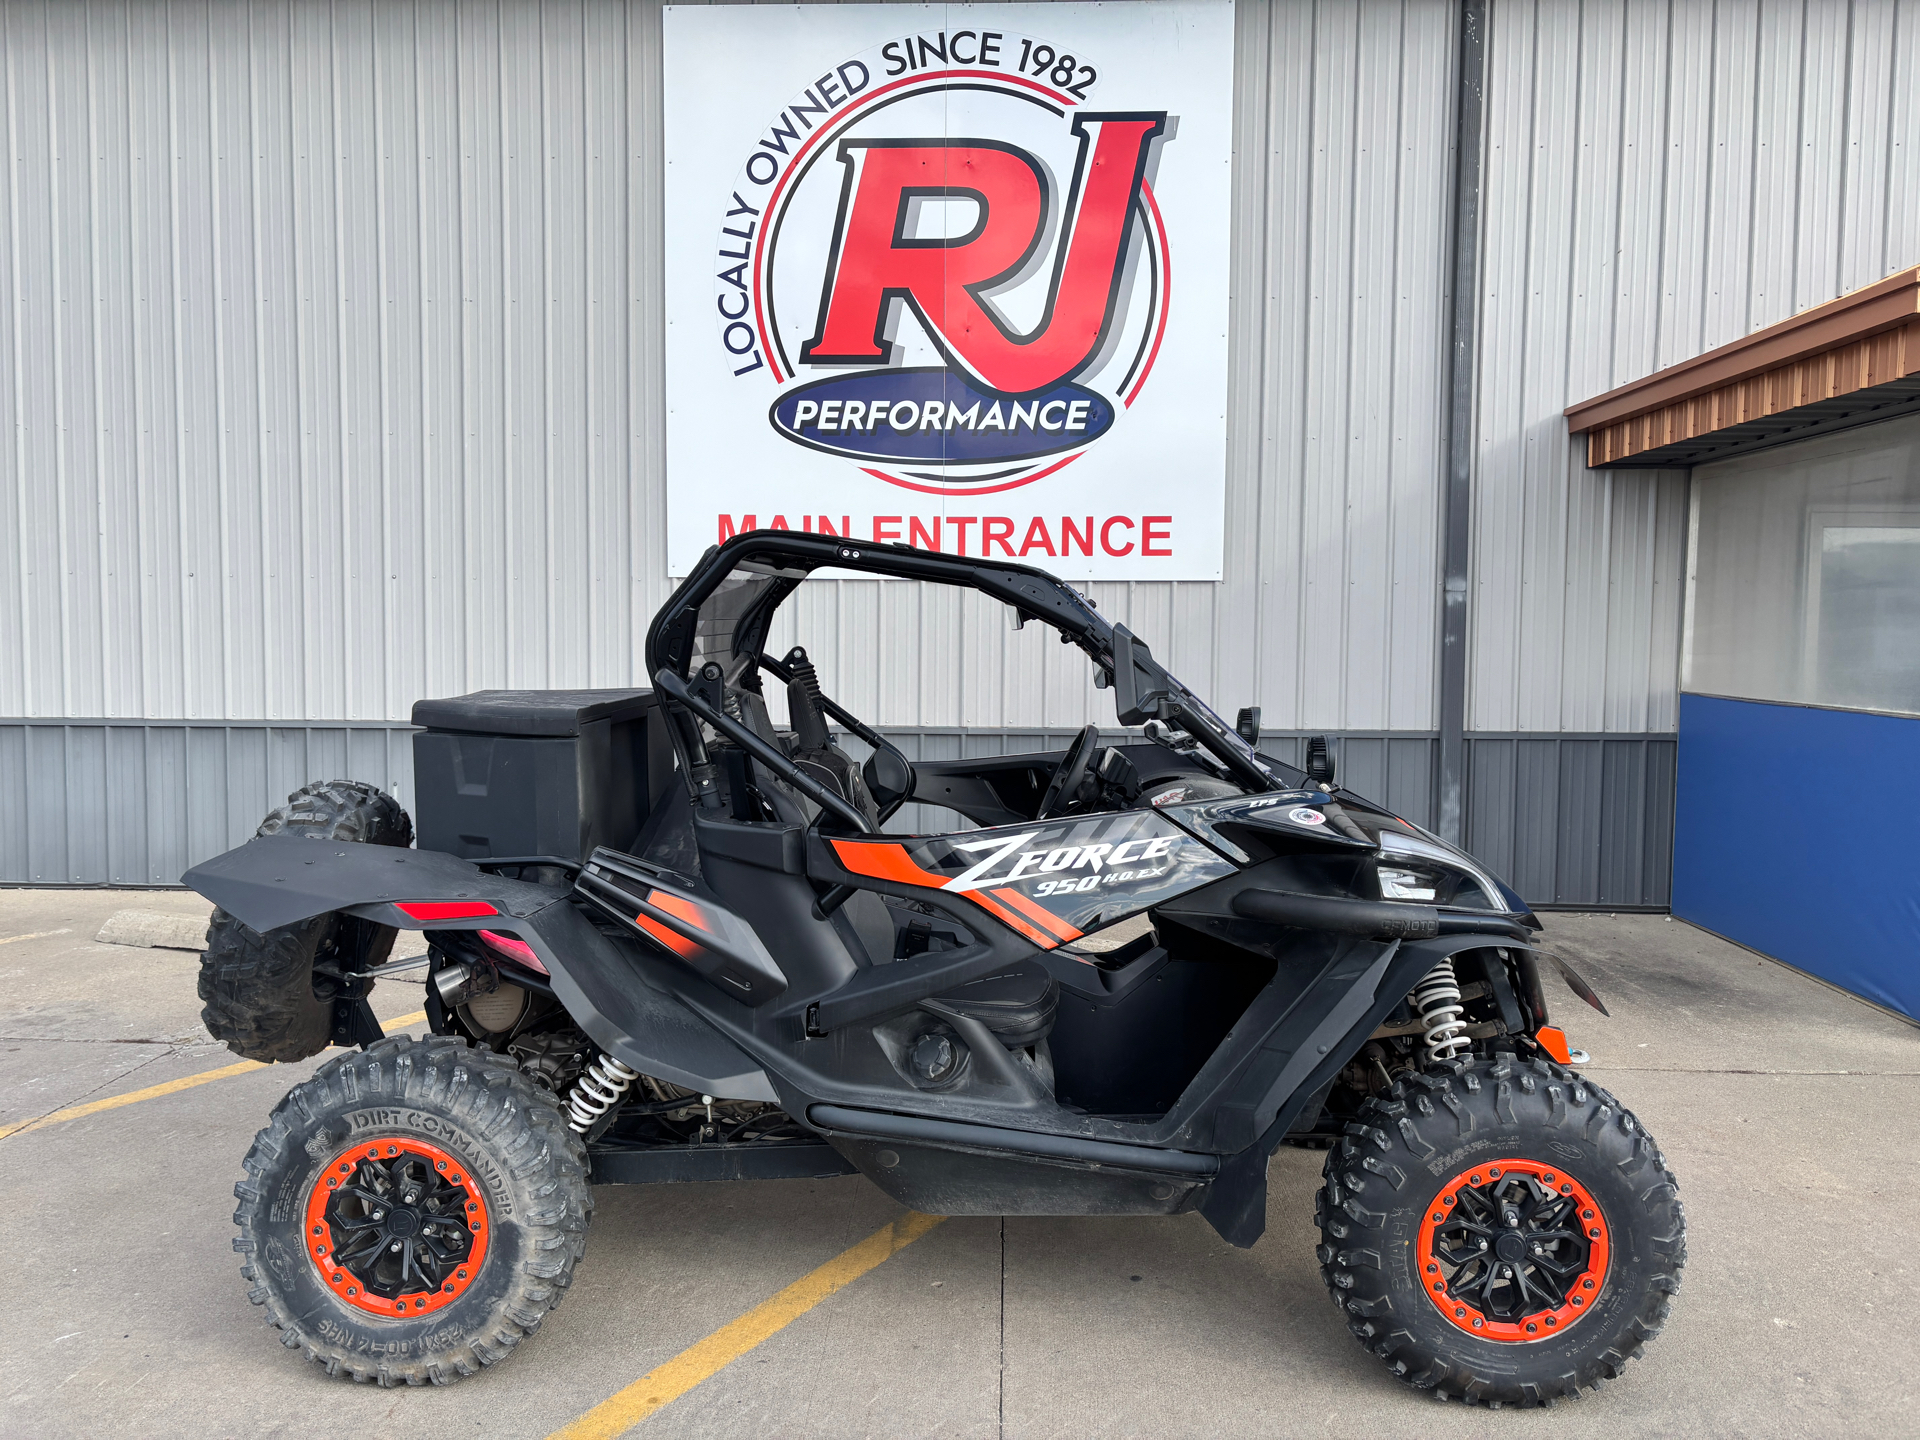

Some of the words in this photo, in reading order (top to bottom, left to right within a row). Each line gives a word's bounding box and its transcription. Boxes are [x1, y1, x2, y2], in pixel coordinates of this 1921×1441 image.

[716, 190, 764, 377] LOCALLY
[746, 59, 870, 185] OWNED
[881, 30, 1003, 76] SINCE
[1018, 38, 1097, 100] 1982
[799, 111, 1168, 398] RJ
[793, 399, 1091, 432] PERFORMANCE
[873, 515, 1173, 557] ENTRANCE
[1249, 798, 1278, 808] EPS
[1032, 875, 1101, 898] 950
[1102, 871, 1134, 883] H.O.
[1136, 866, 1166, 877] EX
[1382, 919, 1437, 930] CFMOTO
[352, 1110, 401, 1129] DIRT
[407, 1111, 513, 1218] COMMANDER
